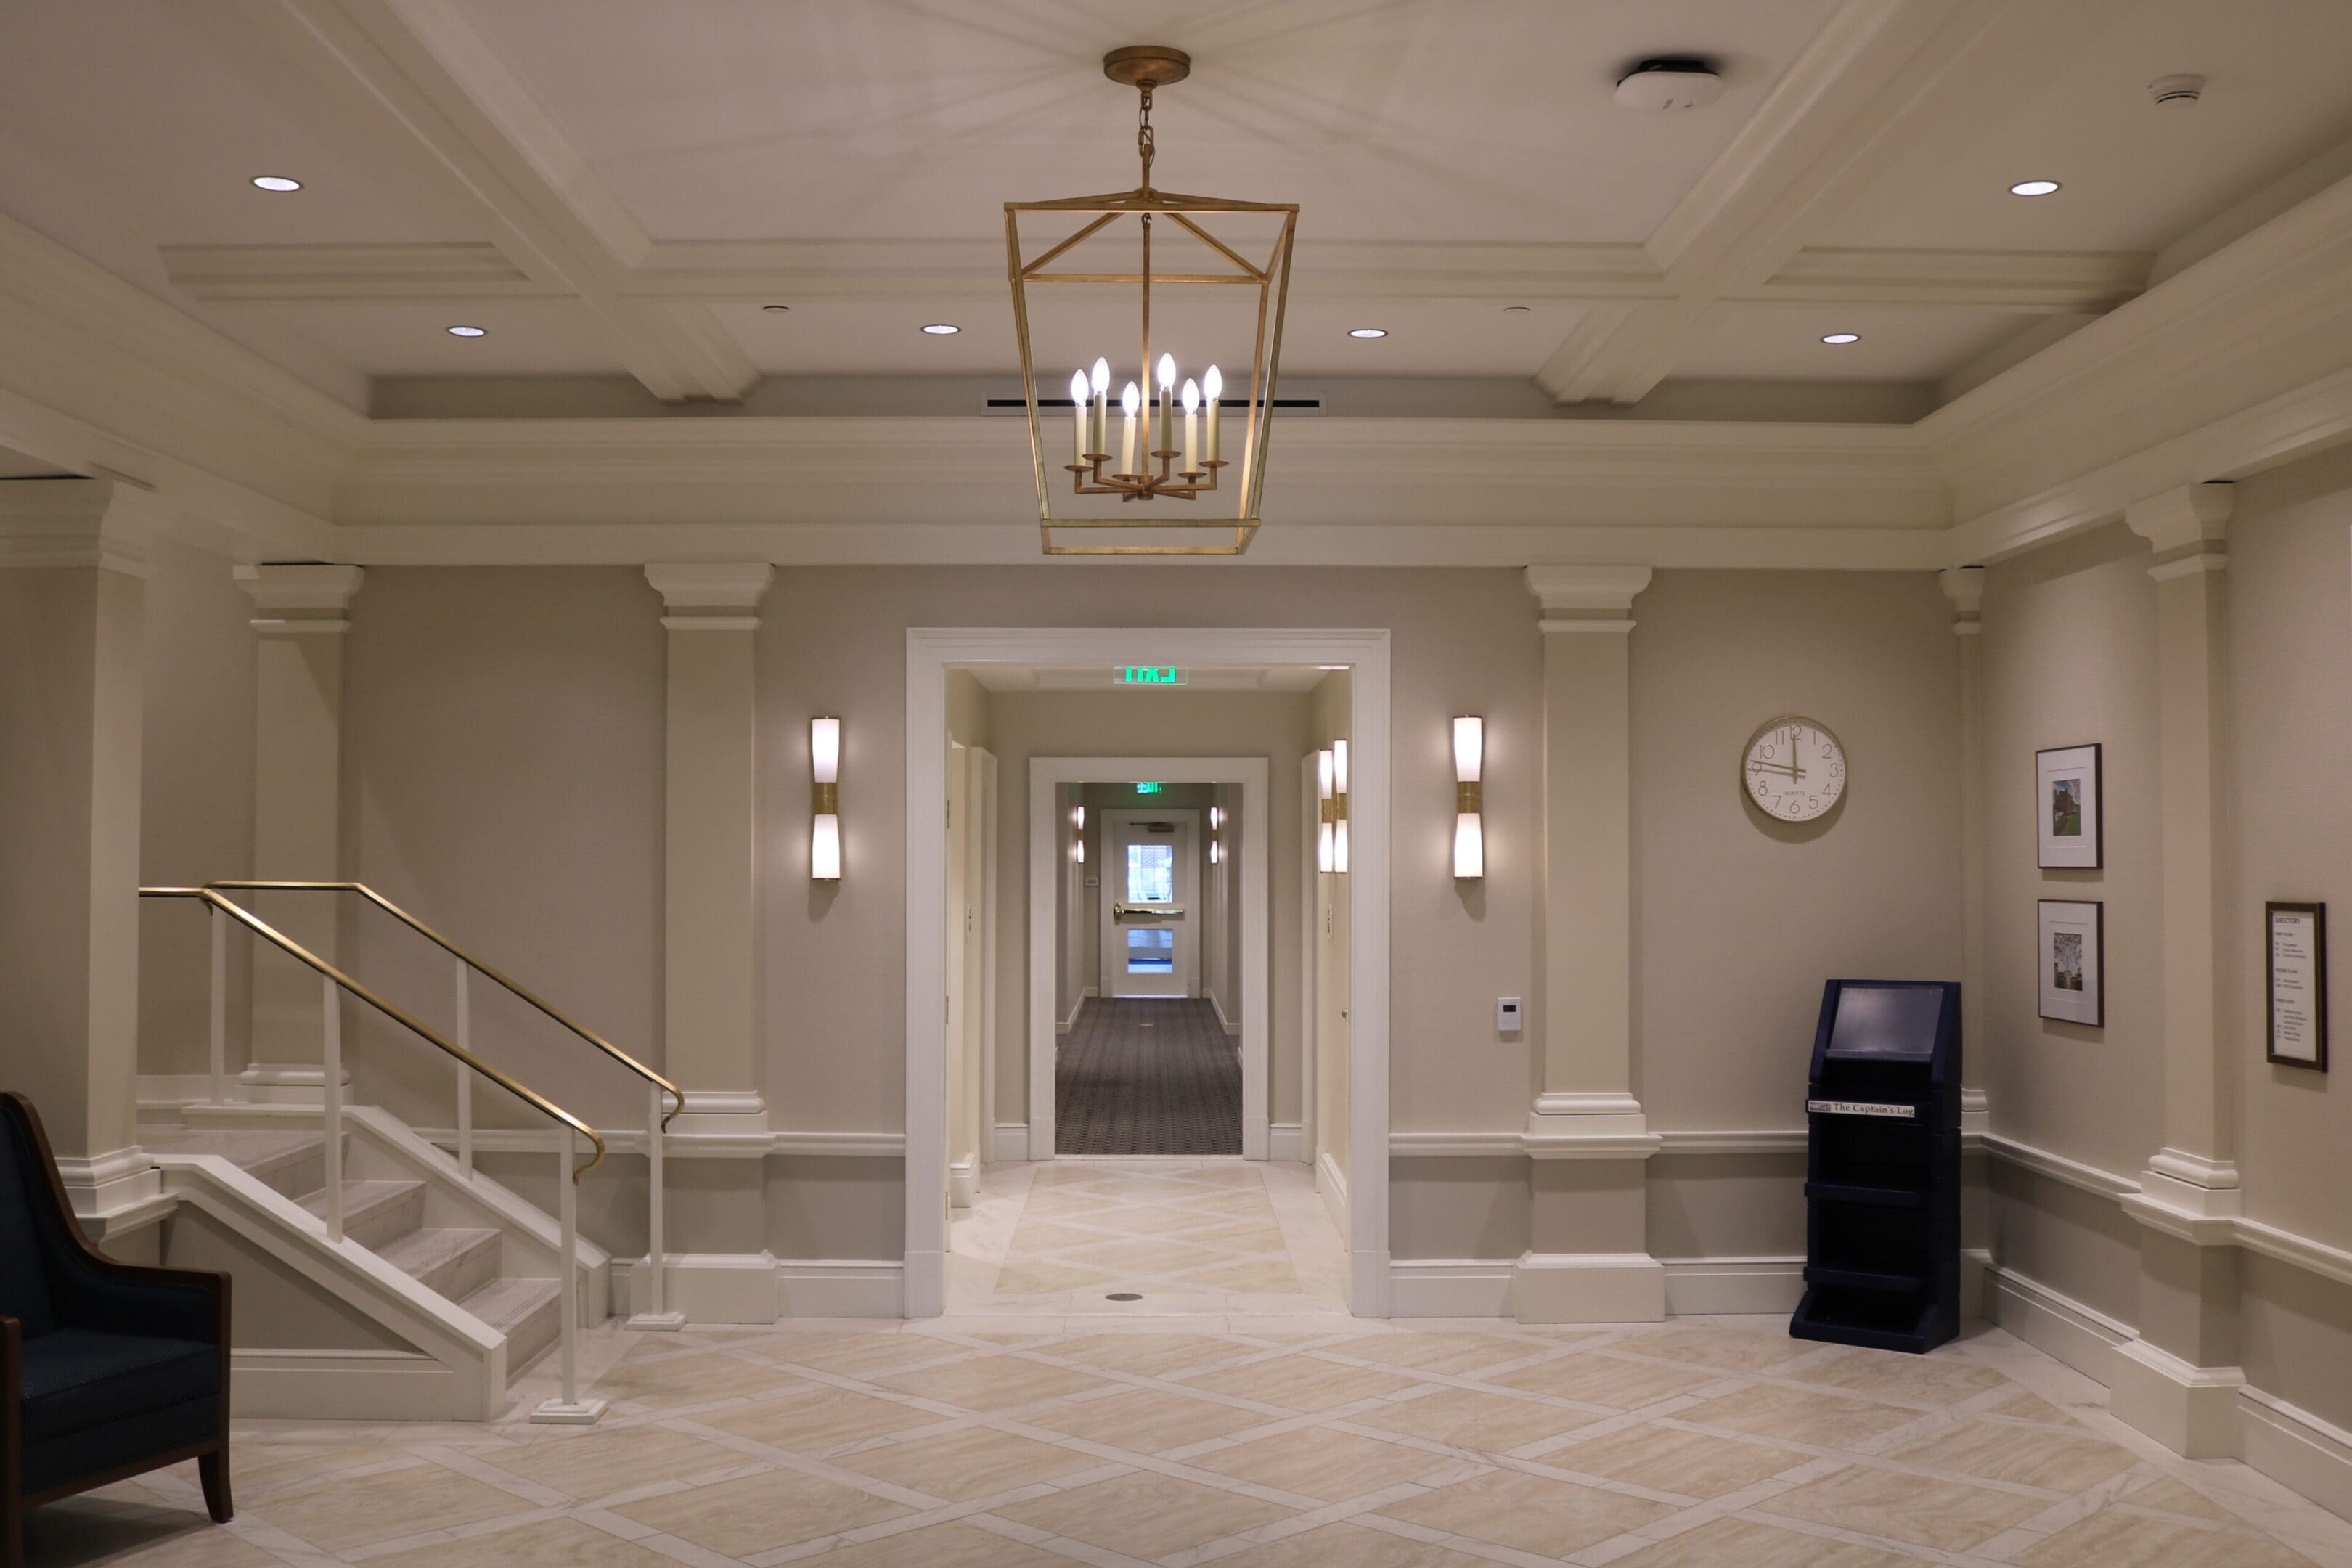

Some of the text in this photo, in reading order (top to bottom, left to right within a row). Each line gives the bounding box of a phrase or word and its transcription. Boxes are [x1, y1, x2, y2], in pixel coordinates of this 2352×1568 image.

[1775, 730, 1784, 745] 11
[1789, 725, 1802, 741] 12
[1813, 730, 1816, 745] 1
[1760, 744, 1775, 759] 10
[1822, 743, 1832, 759] 2
[1752, 763, 1762, 776] 9
[1829, 762, 1838, 778] 3
[1758, 780, 1768, 796] 8
[1822, 783, 1831, 796] 4
[1772, 795, 1781, 809] 7
[1789, 800, 1800, 814] 6
[1808, 795, 1818, 809] 5
[1834, 1103, 1850, 1111] The
[1853, 1104, 1894, 1115] Captain's
[1897, 1106, 1914, 1116] Log
